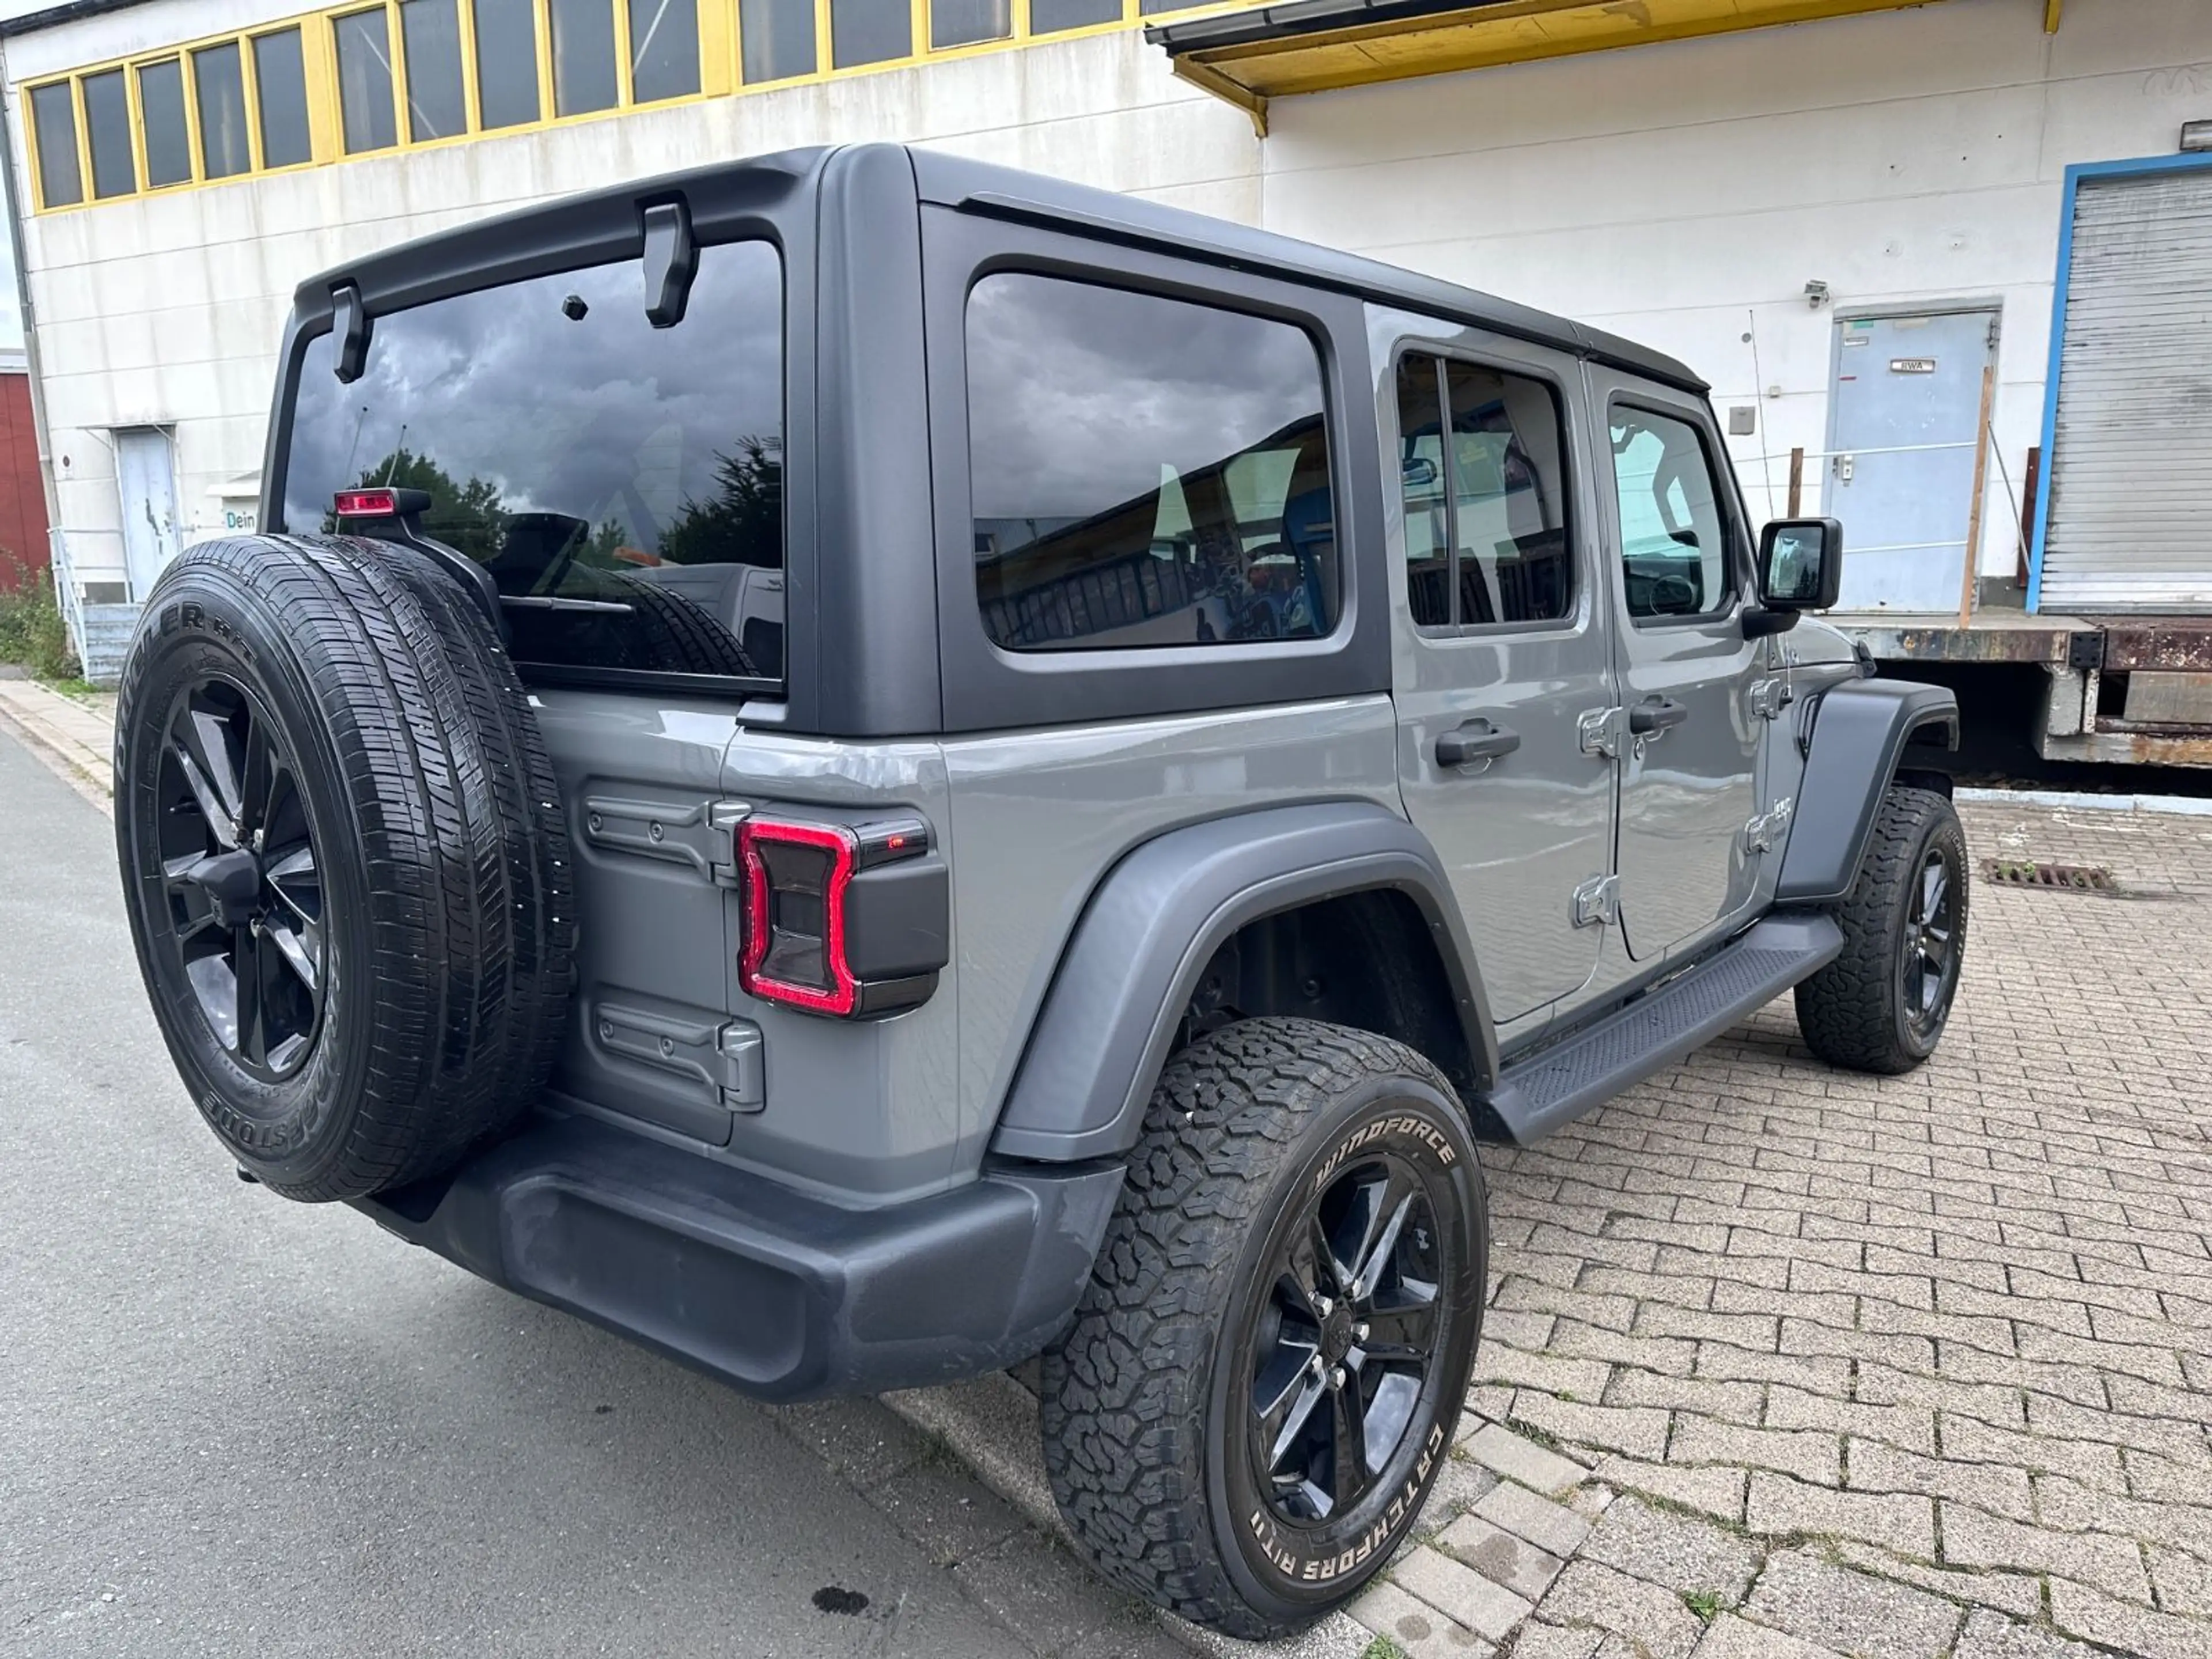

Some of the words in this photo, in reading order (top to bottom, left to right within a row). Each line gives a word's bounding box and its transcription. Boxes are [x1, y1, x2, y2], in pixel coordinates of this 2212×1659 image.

[226, 511, 255, 529] Dein
[1315, 1116, 1456, 1191] WINDFORCE
[1302, 1422, 1445, 1580] CATCHFORS
